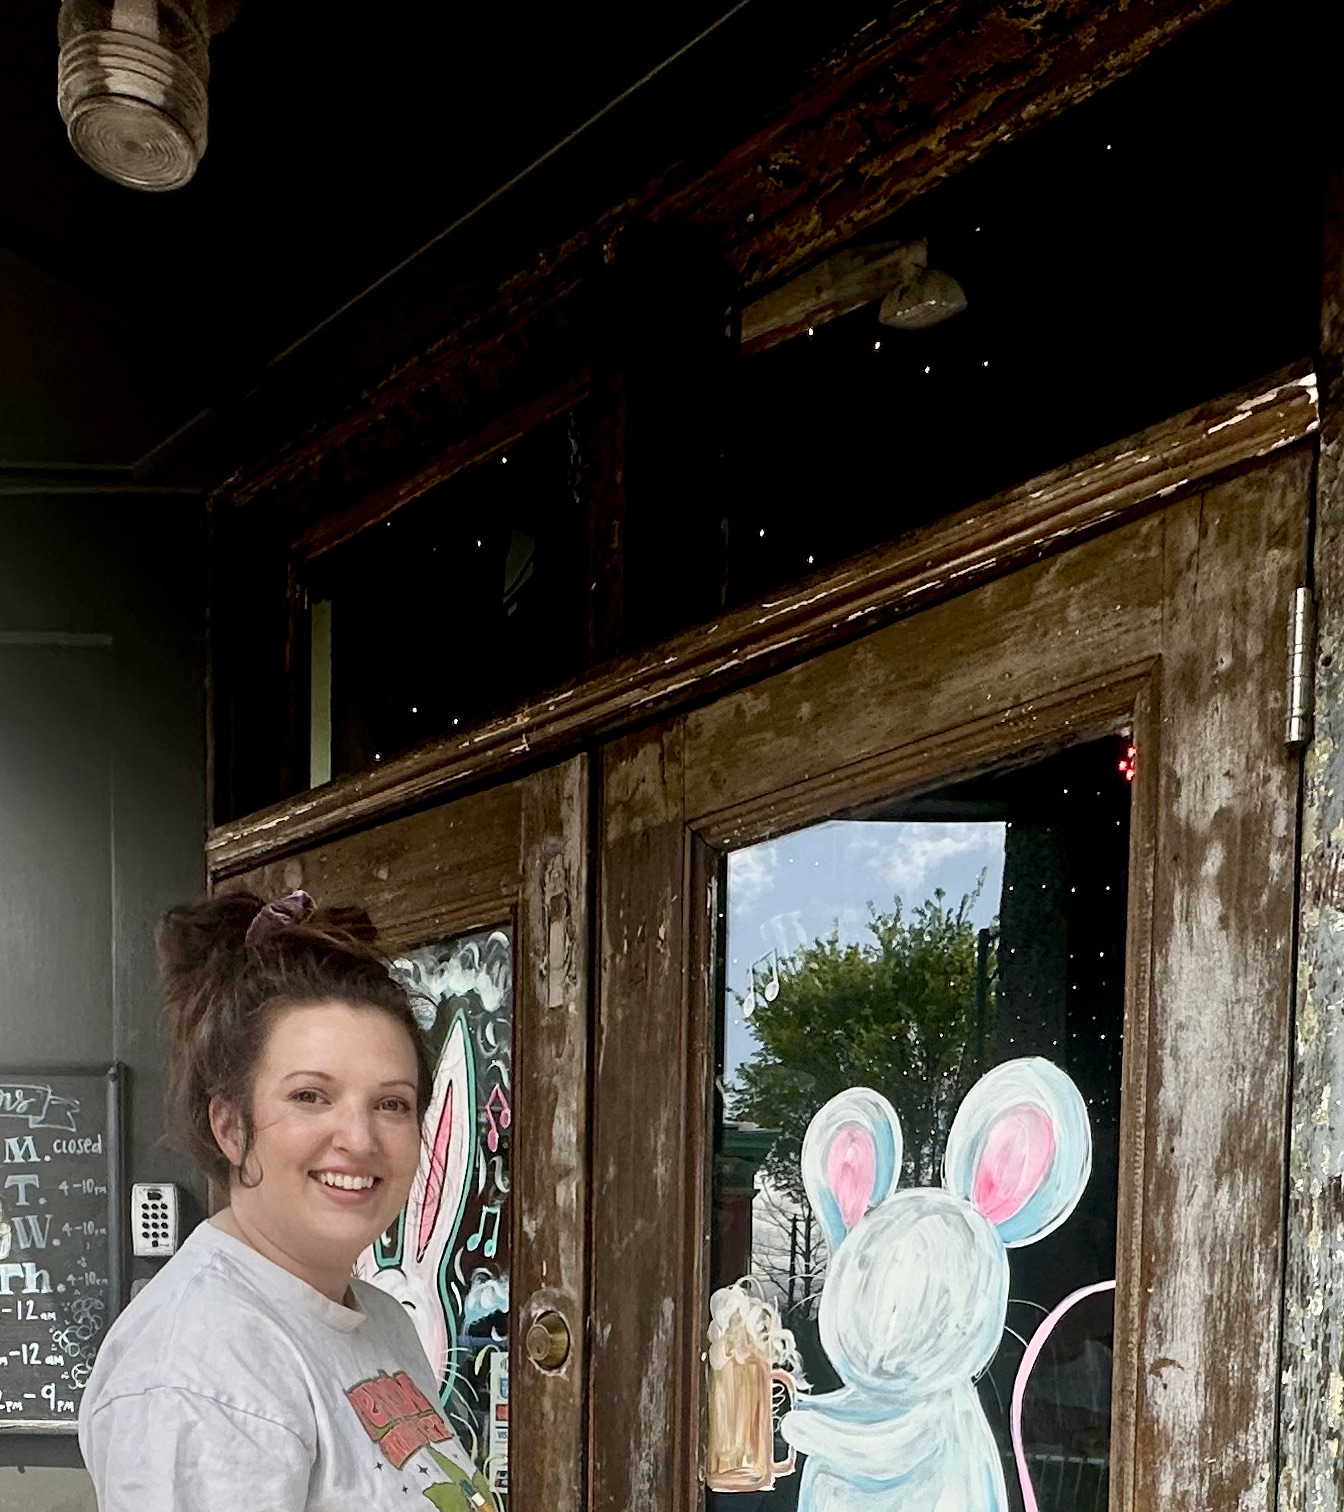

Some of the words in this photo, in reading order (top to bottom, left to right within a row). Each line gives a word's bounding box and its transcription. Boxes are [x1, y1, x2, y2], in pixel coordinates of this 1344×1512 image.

[4, 1136, 52, 1163] M.
[4, 1174, 47, 1206] T.
[11, 1214, 61, 1249] W.
[497, 1431, 508, 1441] VIS
